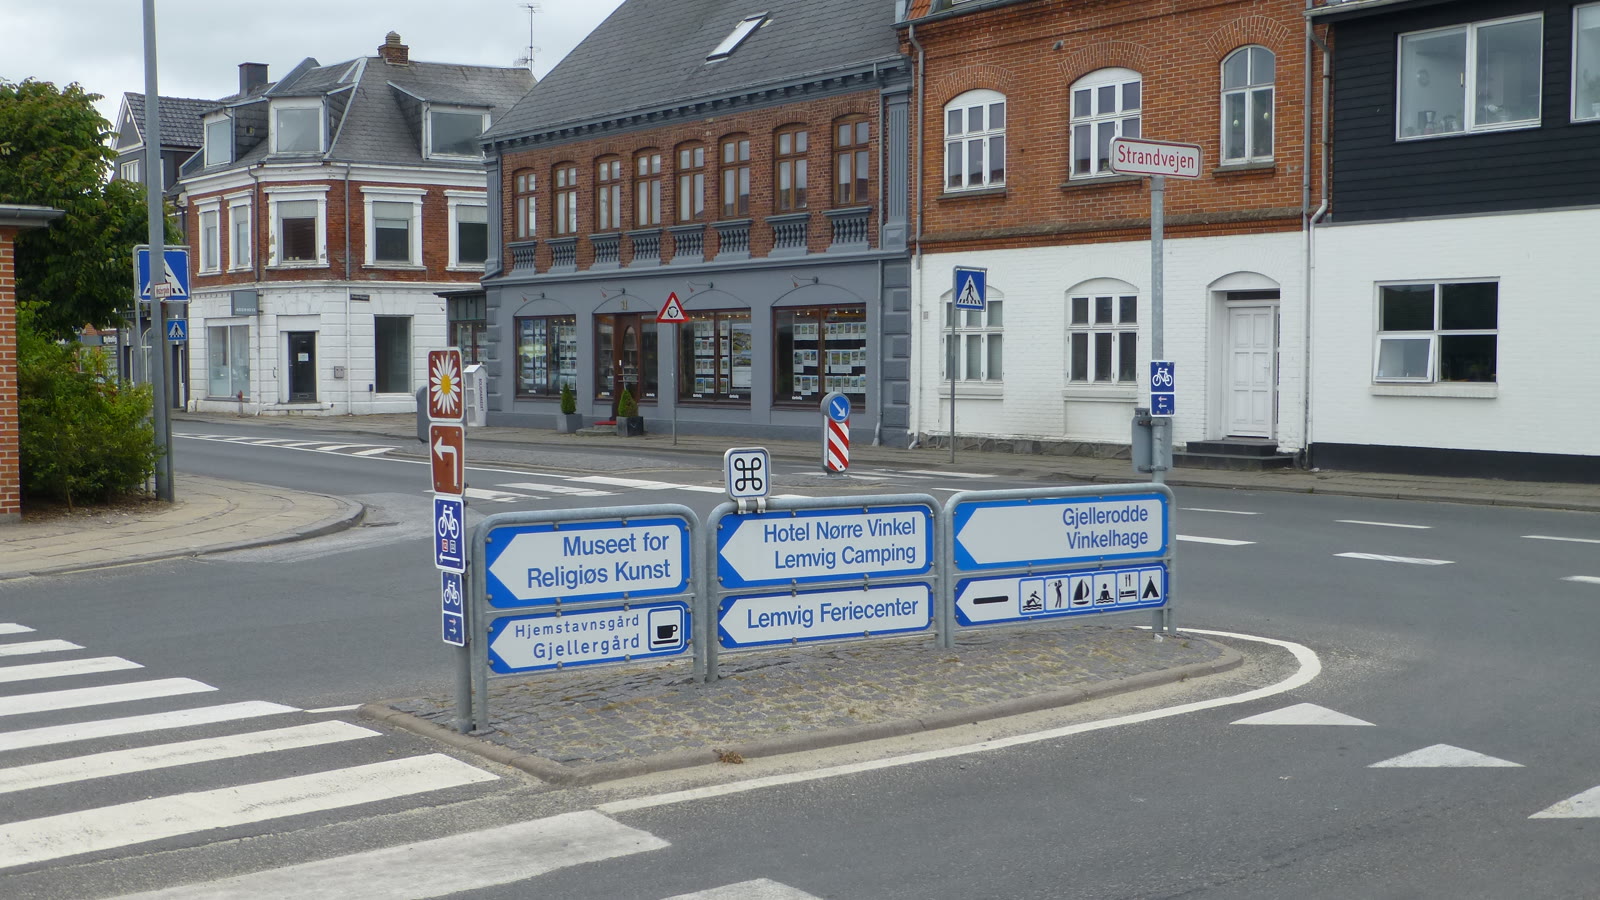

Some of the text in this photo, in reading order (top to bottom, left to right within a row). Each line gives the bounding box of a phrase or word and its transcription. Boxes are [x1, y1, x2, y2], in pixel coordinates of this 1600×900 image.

[1118, 144, 1194, 173] Strandvejen
[764, 516, 916, 543] Hotel Nørre Vinkel
[1062, 505, 1148, 529] Gjellerodde
[563, 532, 670, 556] Museet for
[1066, 530, 1148, 550] Vinkelhage
[775, 544, 916, 570] Lemvig Camping
[527, 559, 671, 590] Religiøs Kunst
[515, 614, 639, 638] Hjemstavnsgård
[747, 598, 919, 629] Lemvig Feriecenter
[533, 634, 640, 660] Gjellergård
